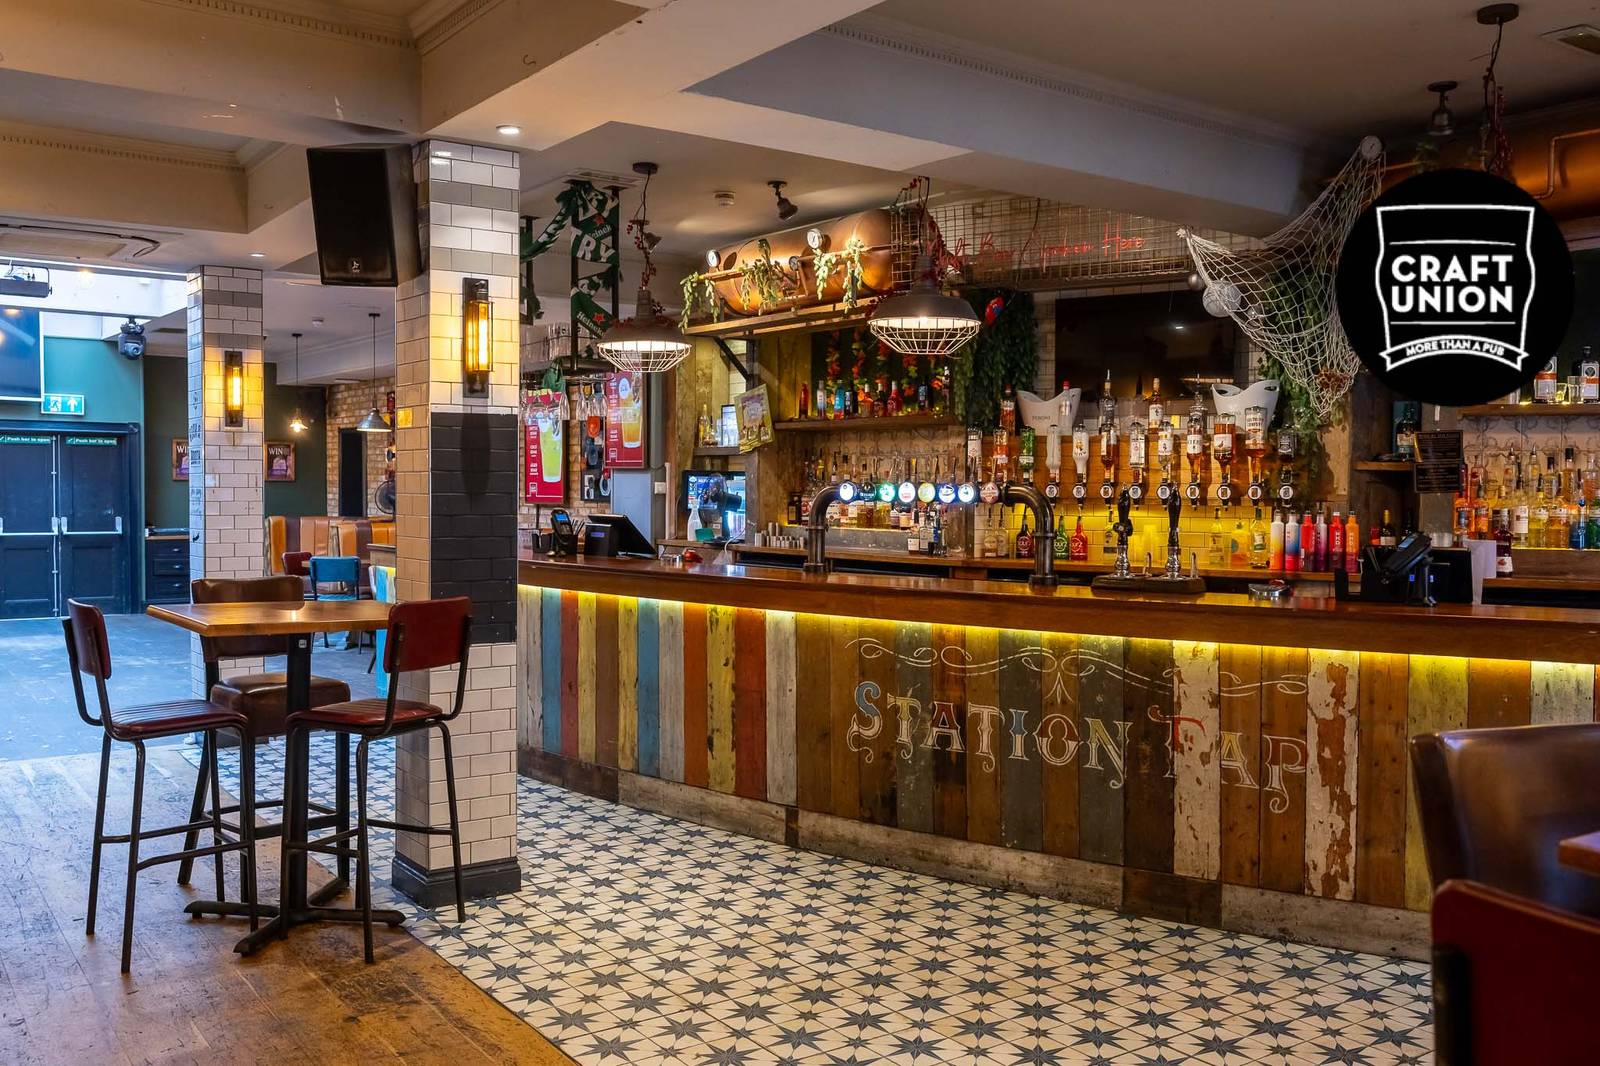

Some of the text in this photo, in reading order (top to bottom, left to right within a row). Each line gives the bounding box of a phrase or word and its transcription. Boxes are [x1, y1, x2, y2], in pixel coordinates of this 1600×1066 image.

[1102, 218, 1146, 260] Here
[176, 445, 189, 454] WI
[269, 447, 283, 455] WIN
[845, 680, 1308, 814] STATION TAP
